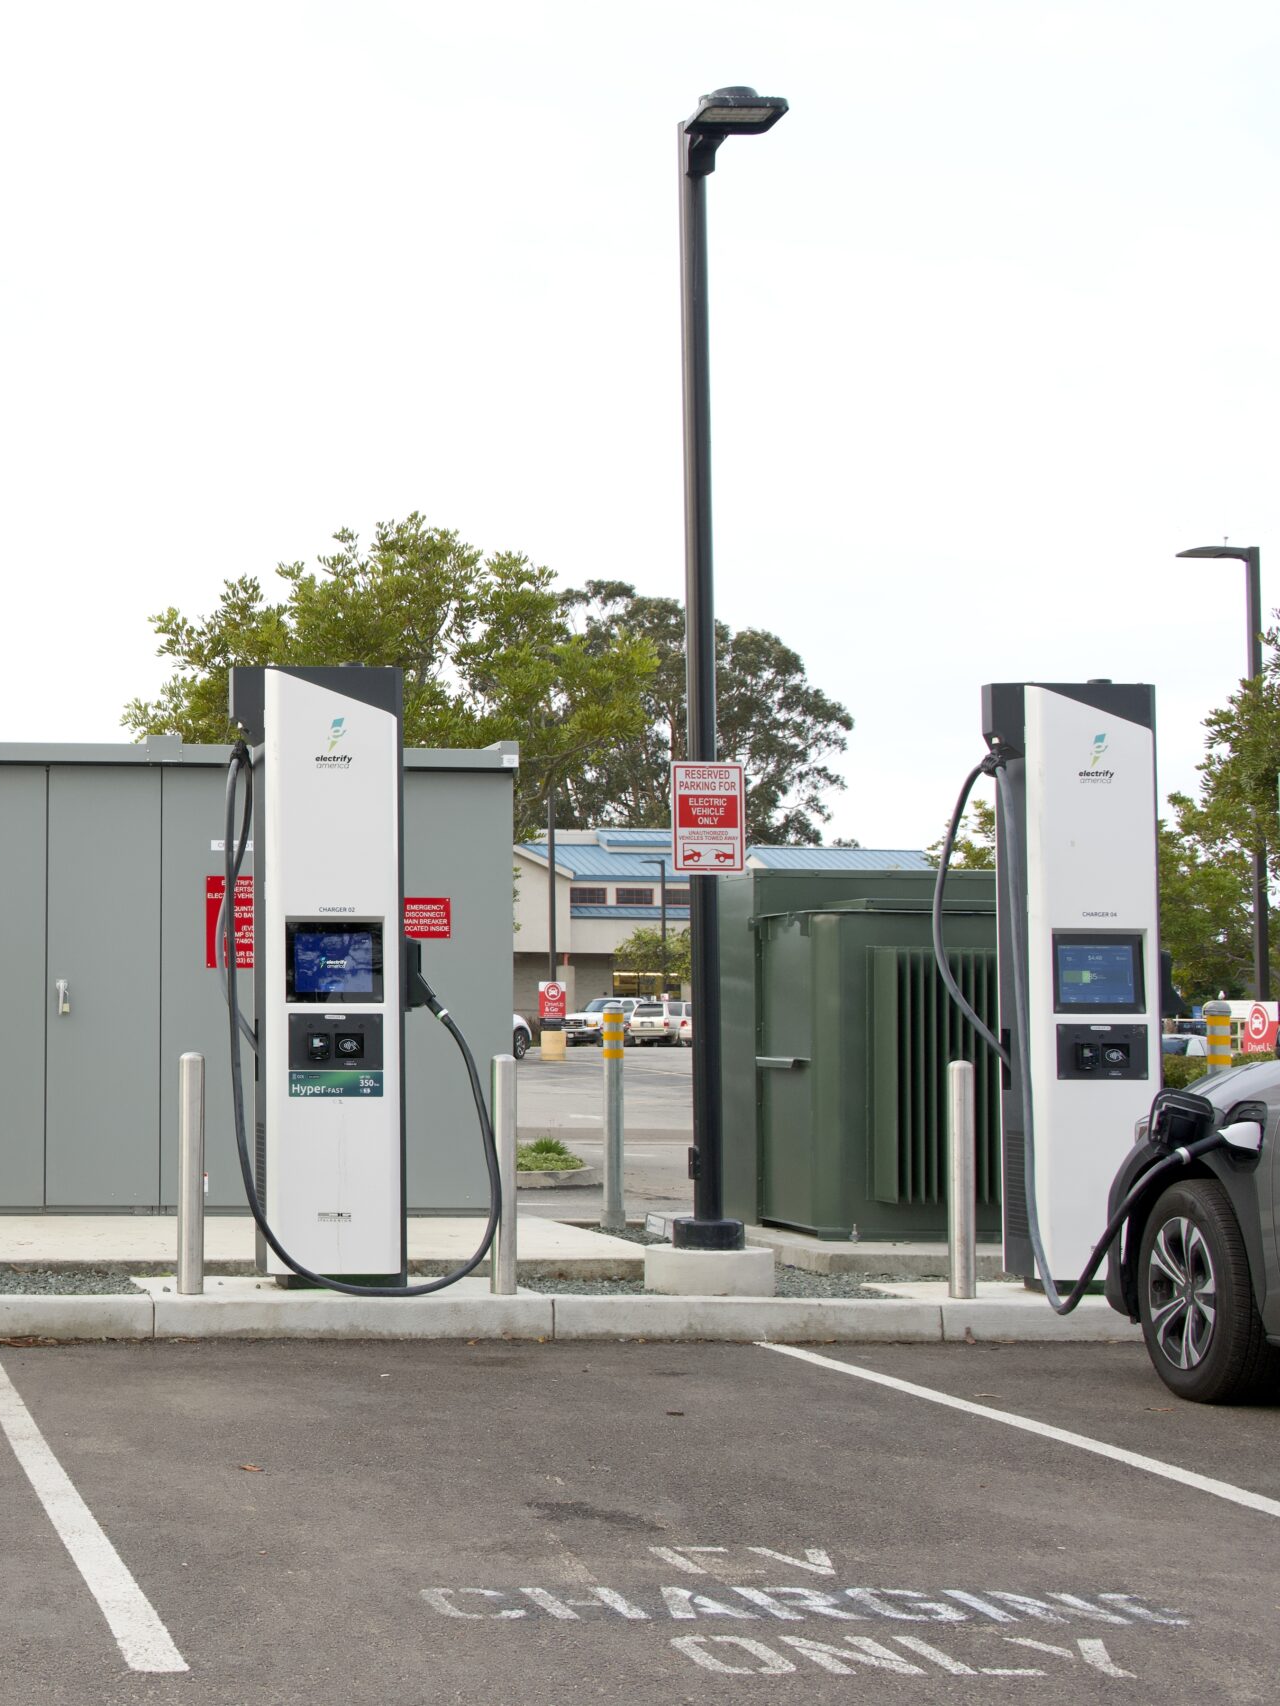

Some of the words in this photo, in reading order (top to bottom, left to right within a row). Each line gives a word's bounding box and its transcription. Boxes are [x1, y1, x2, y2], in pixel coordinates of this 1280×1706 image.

[315, 755, 353, 764] electrify
[685, 769, 730, 779] RESERVED
[1079, 770, 1115, 778] electrify
[680, 781, 716, 791] PARKING
[719, 782, 736, 791] FOR
[688, 798, 727, 806] ELECTRIC
[691, 808, 725, 816] VEHICLE
[698, 817, 719, 825] ONLY
[292, 1083, 344, 1096] Hyper-FAST
[360, 1079, 374, 1087] 350
[670, 1635, 1137, 1678] ONLY
